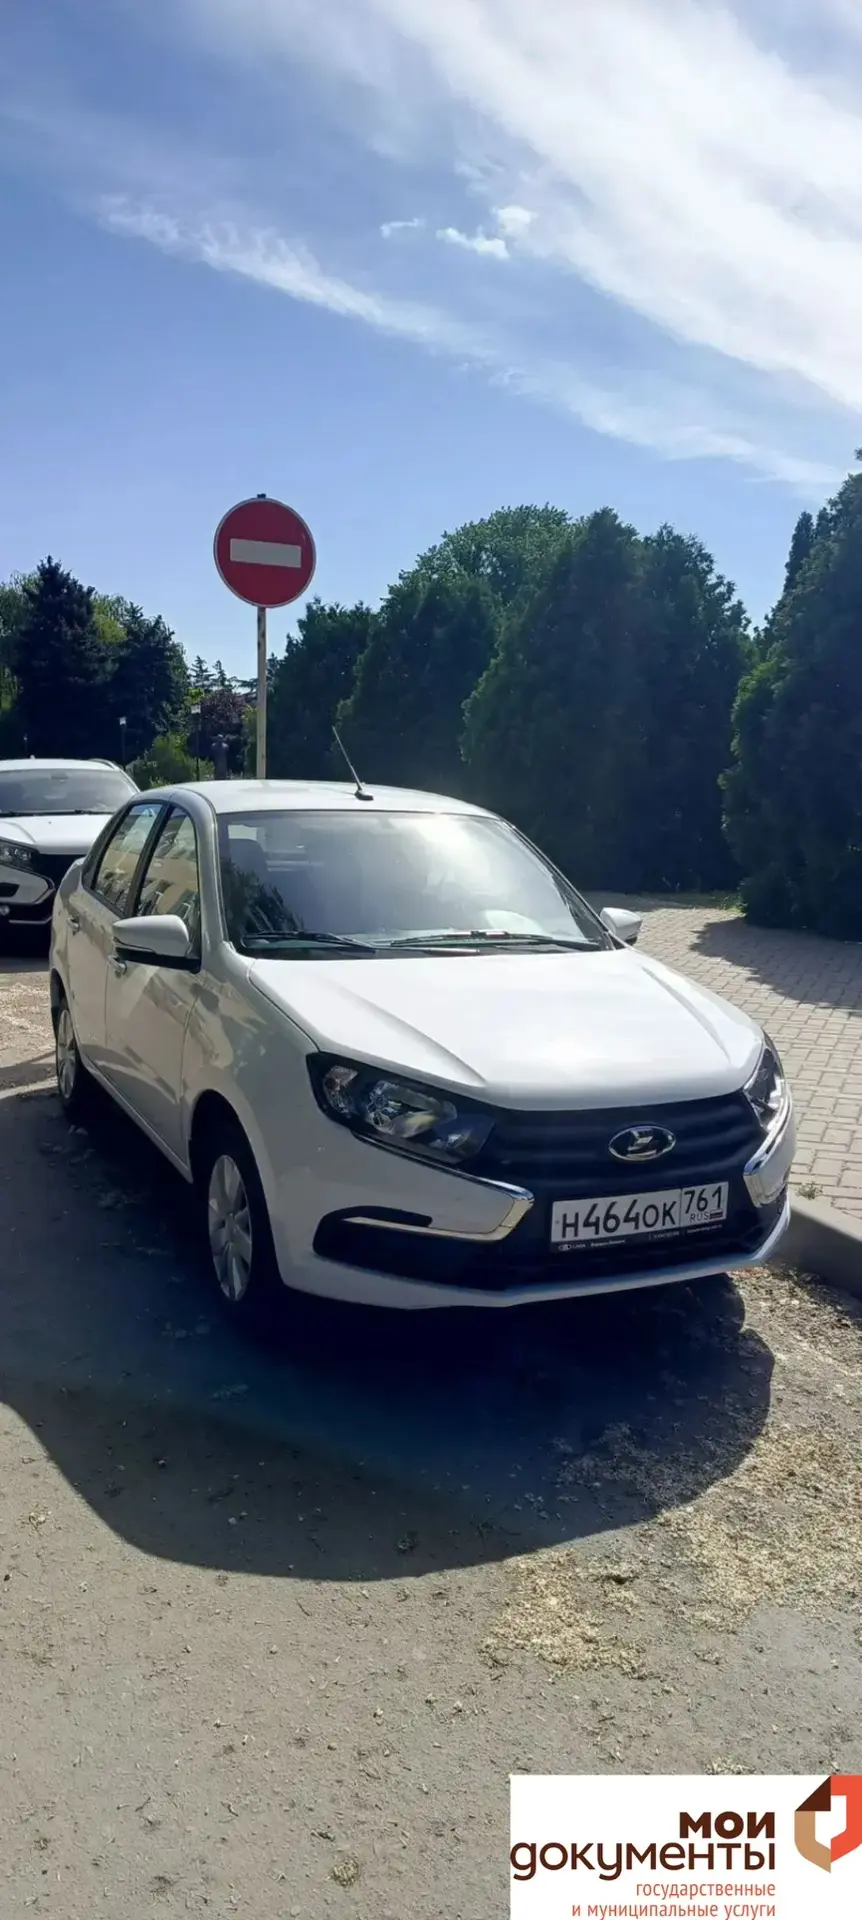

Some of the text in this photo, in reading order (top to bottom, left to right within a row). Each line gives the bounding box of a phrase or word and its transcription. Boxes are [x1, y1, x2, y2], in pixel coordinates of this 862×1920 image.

[562, 1186, 722, 1238] Н464ОК 761
[689, 1211, 709, 1223] RUS
